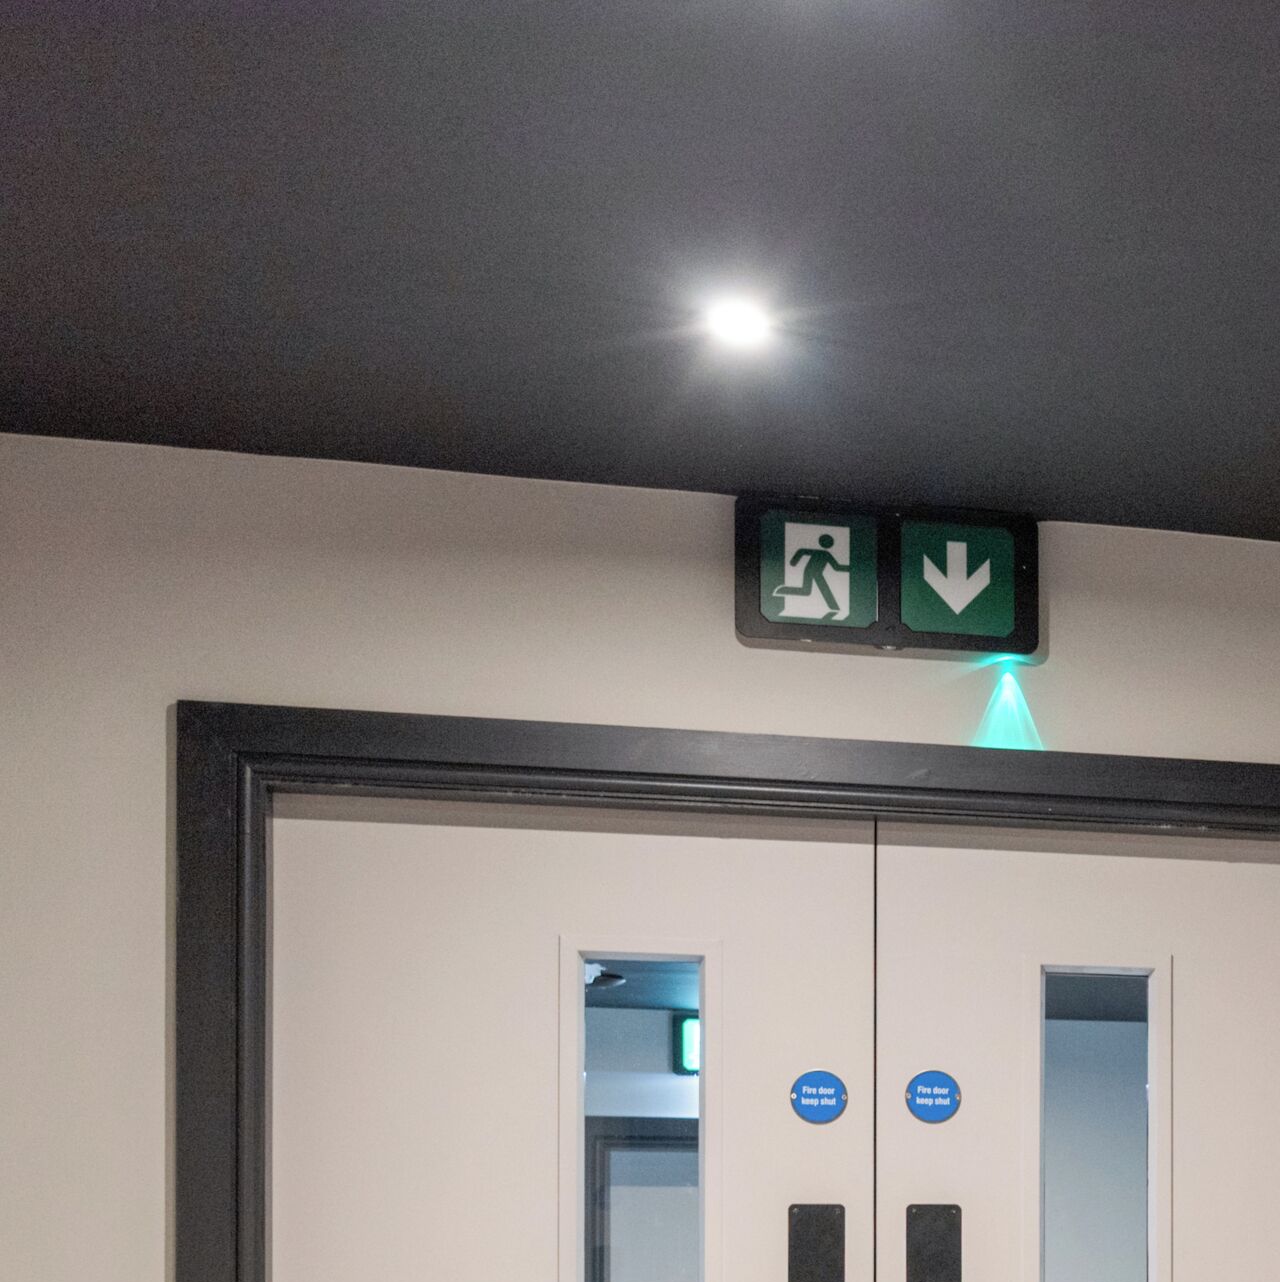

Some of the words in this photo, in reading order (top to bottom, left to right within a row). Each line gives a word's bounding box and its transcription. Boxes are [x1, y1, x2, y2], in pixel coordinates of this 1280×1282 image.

[802, 1085, 817, 1095] Fire
[818, 1086, 835, 1095] door
[917, 1085, 932, 1095] Fire
[932, 1086, 949, 1095] door
[801, 1096, 819, 1107] keep
[820, 1096, 836, 1106] shut
[916, 1096, 934, 1107] keep
[934, 1096, 951, 1106] shut
